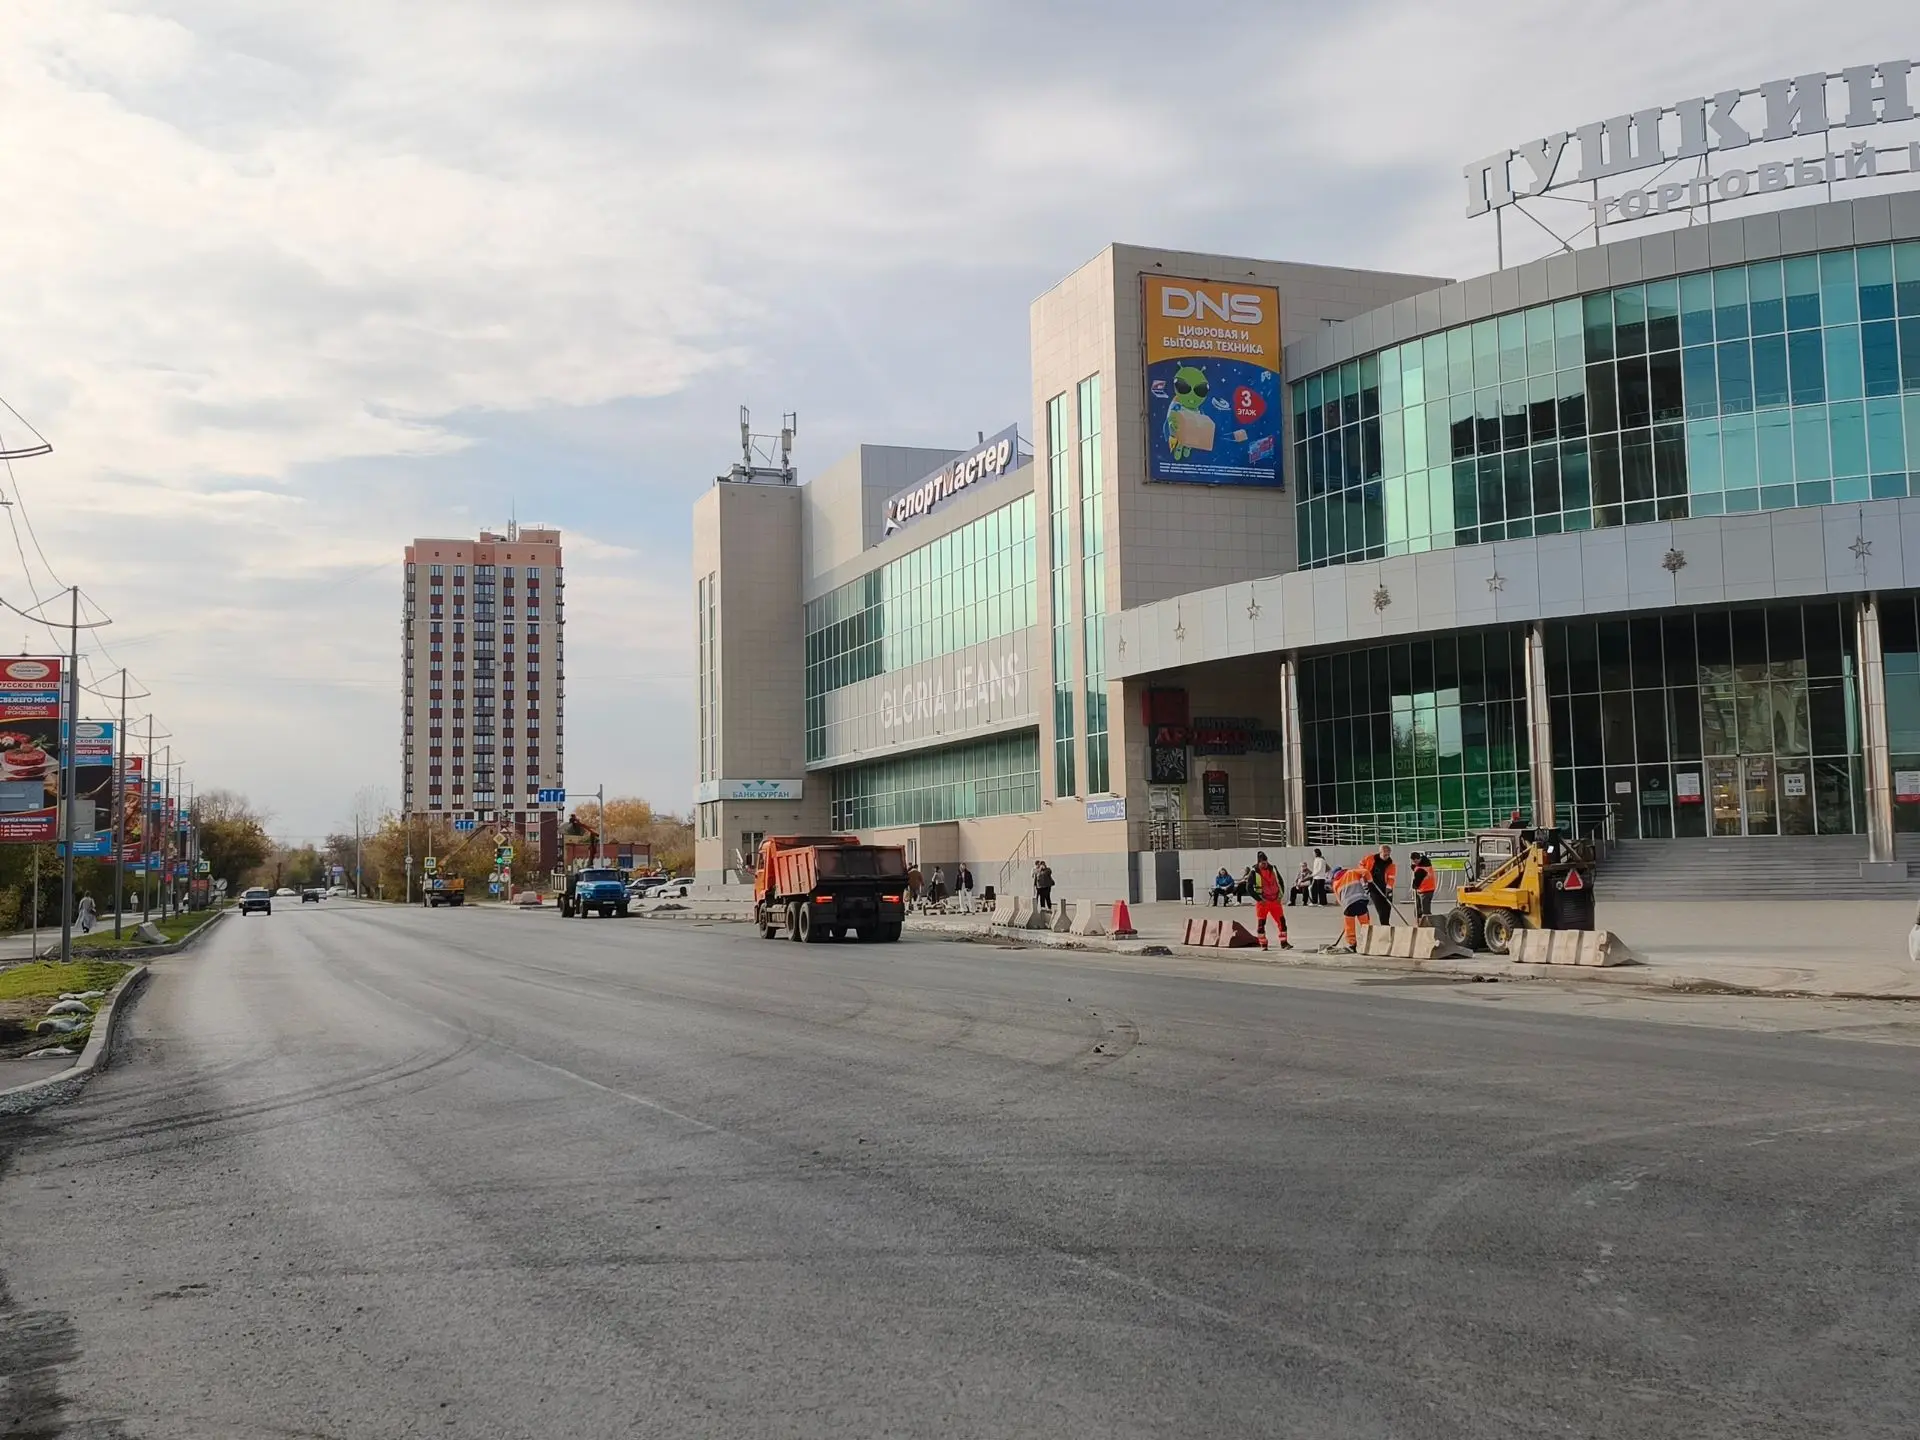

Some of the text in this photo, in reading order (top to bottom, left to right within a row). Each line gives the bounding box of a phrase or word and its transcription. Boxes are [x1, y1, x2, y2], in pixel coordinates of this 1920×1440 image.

[1588, 140, 1875, 226] ТОРГОВЫЙ
[1162, 286, 1263, 325] DNS
[1178, 325, 1249, 341] ЦИФРОВАЯ И
[1163, 336, 1264, 354] БЫТОВАЯ ТЕХНИКА
[1241, 390, 1252, 407] 3
[1236, 408, 1257, 416] ЭТАЖ
[881, 652, 1020, 729] GLORIA JEANS
